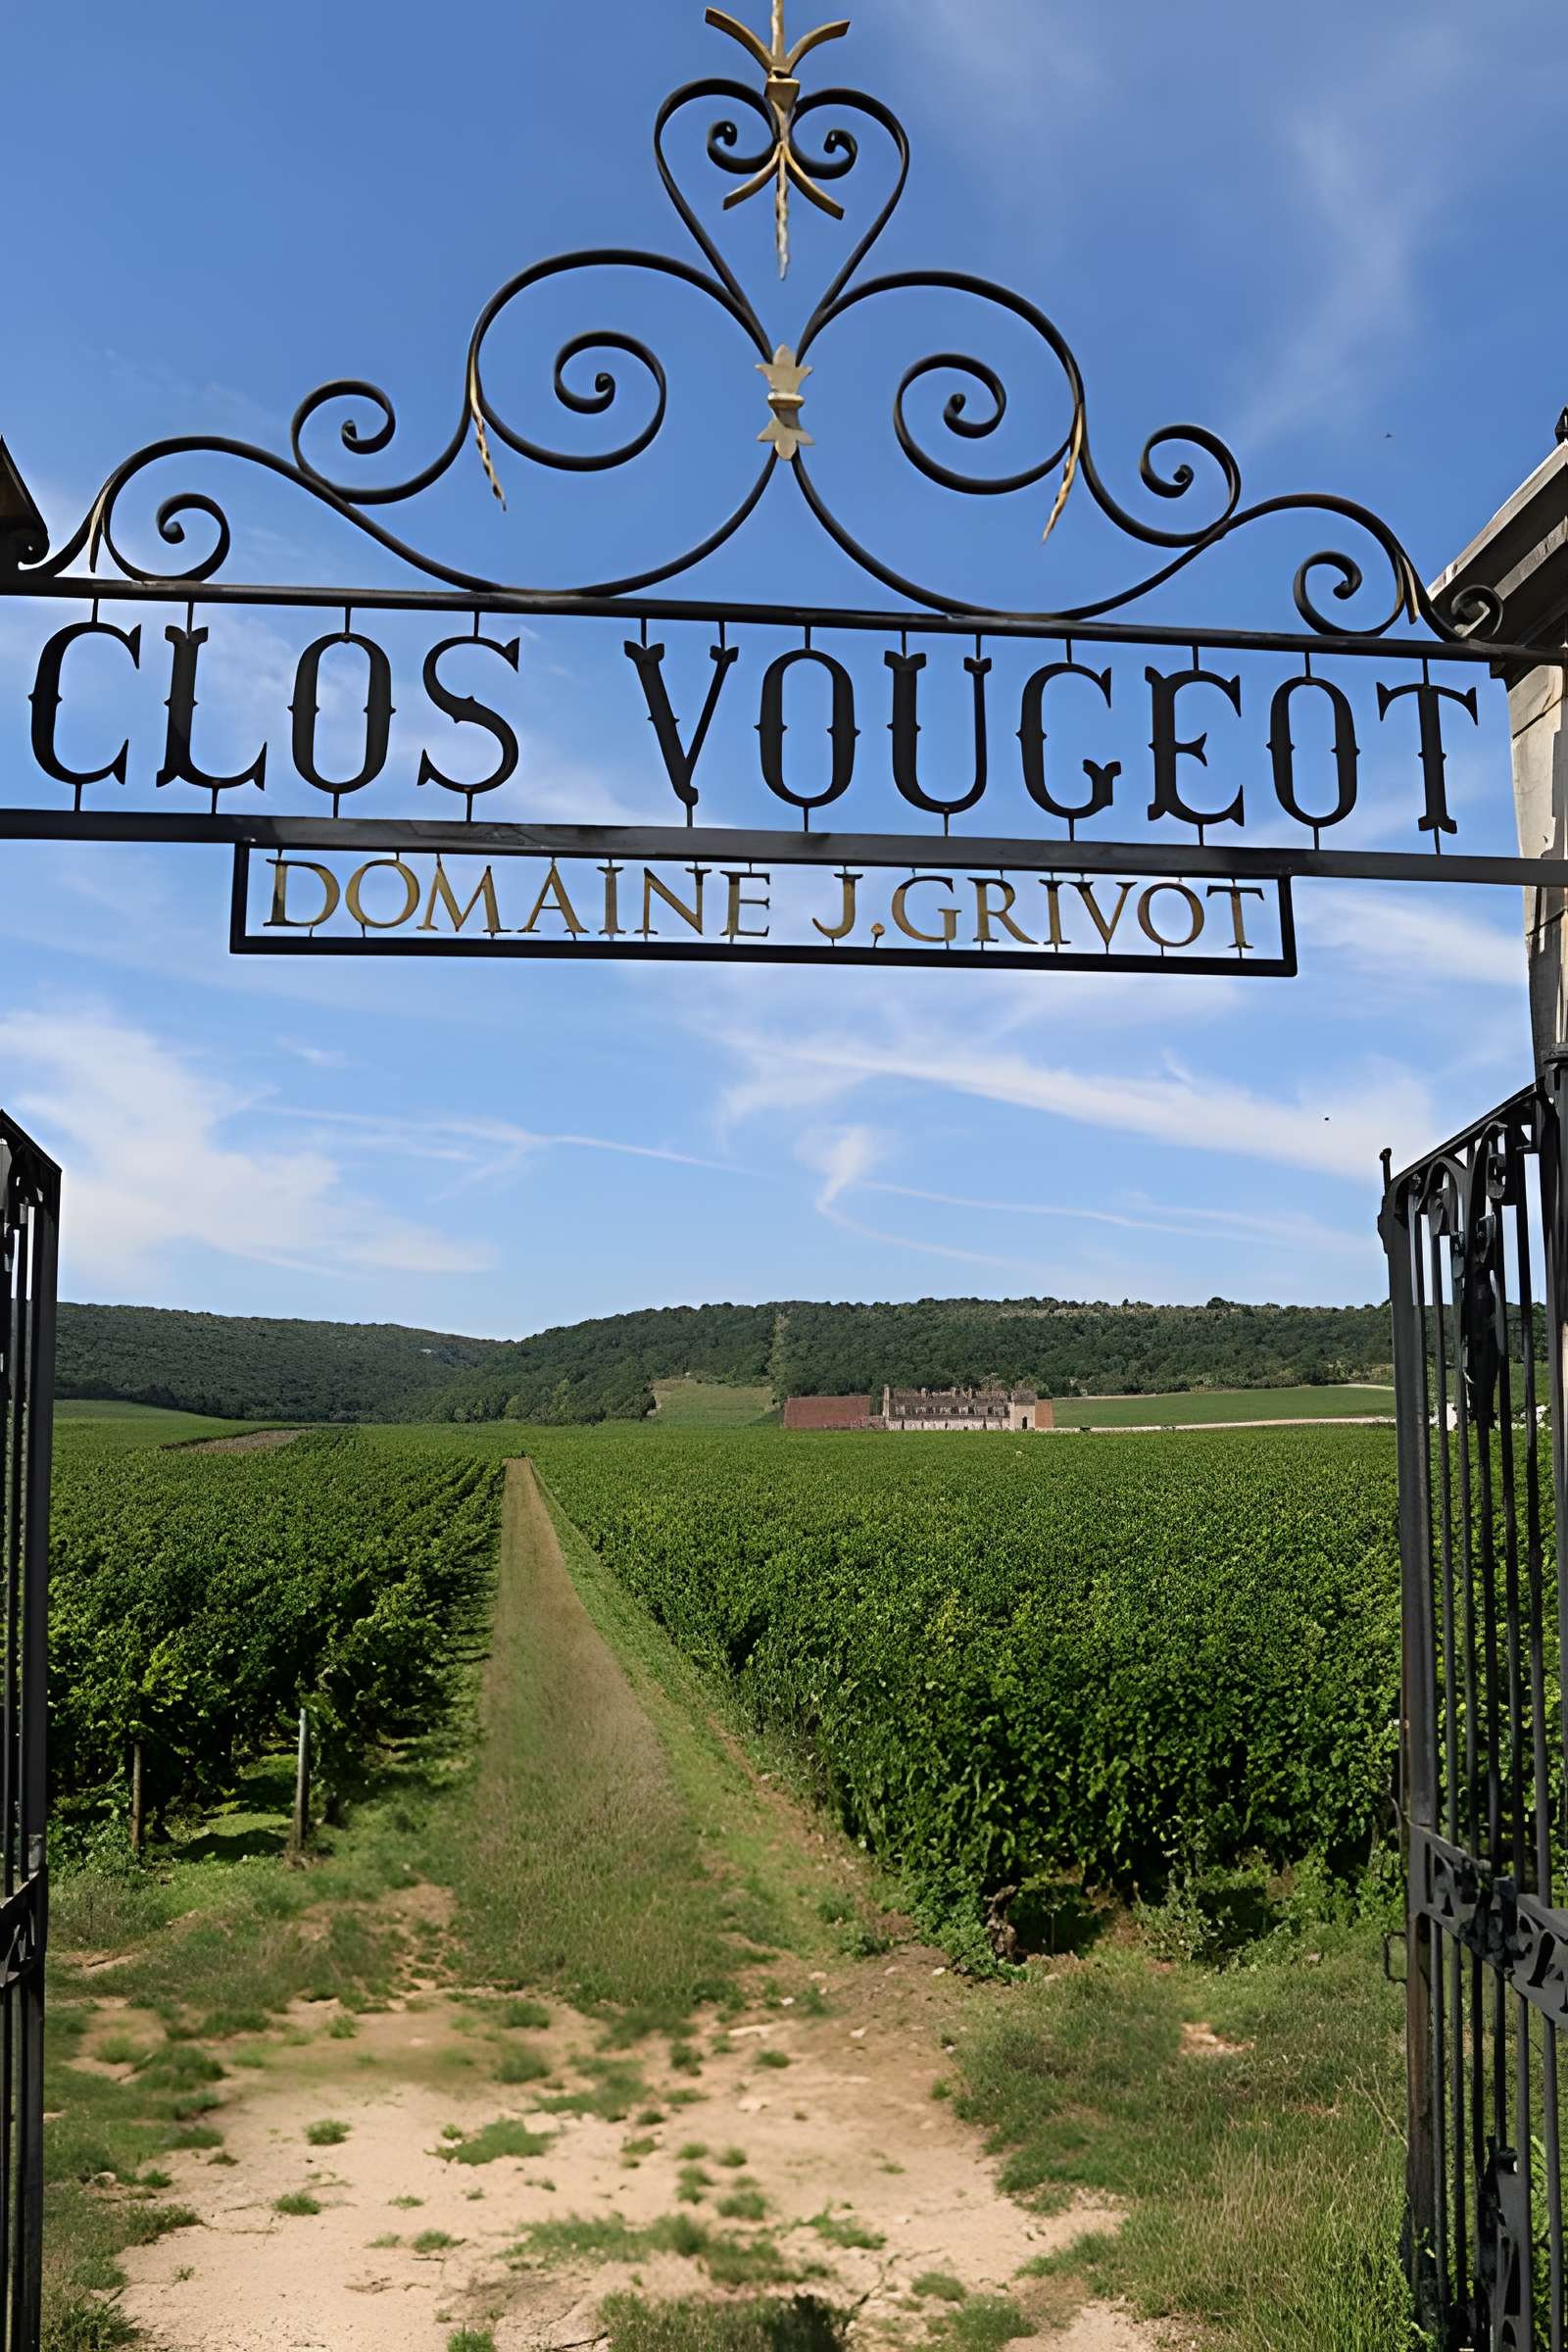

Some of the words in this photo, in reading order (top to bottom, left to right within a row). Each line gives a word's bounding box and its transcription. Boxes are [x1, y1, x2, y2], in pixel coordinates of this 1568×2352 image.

[28, 622, 520, 794] CLOS
[623, 639, 1479, 834] VOUGEOT
[263, 858, 771, 938] DOMAINE
